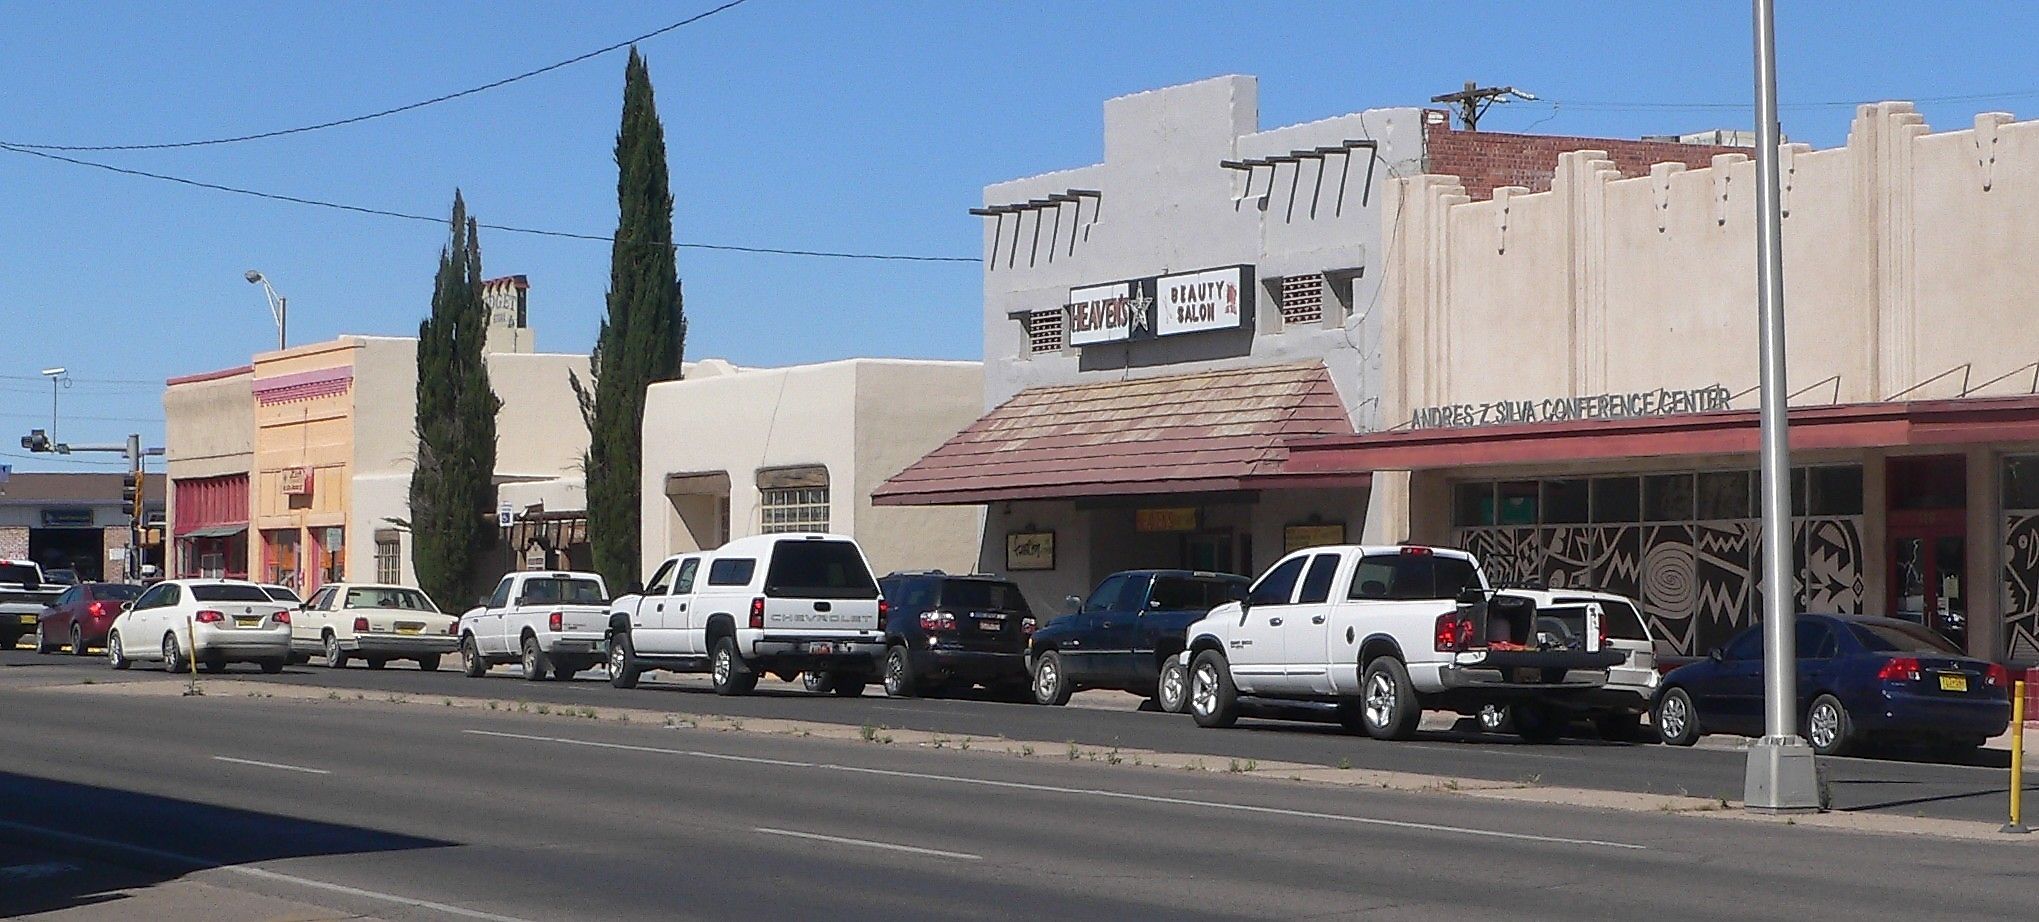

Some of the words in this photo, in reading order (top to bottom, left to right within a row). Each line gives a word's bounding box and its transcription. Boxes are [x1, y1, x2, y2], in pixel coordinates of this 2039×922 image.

[1171, 280, 1225, 304] BEAUTY
[1177, 302, 1215, 324] SALON
[1411, 403, 1474, 430] ANDRES
[1479, 403, 1490, 424] Z
[1496, 400, 1536, 424] SILVA
[1542, 392, 1654, 423] CONFERENCE
[1660, 387, 1731, 415] CENTER
[770, 614, 873, 623] CHEVROLET
